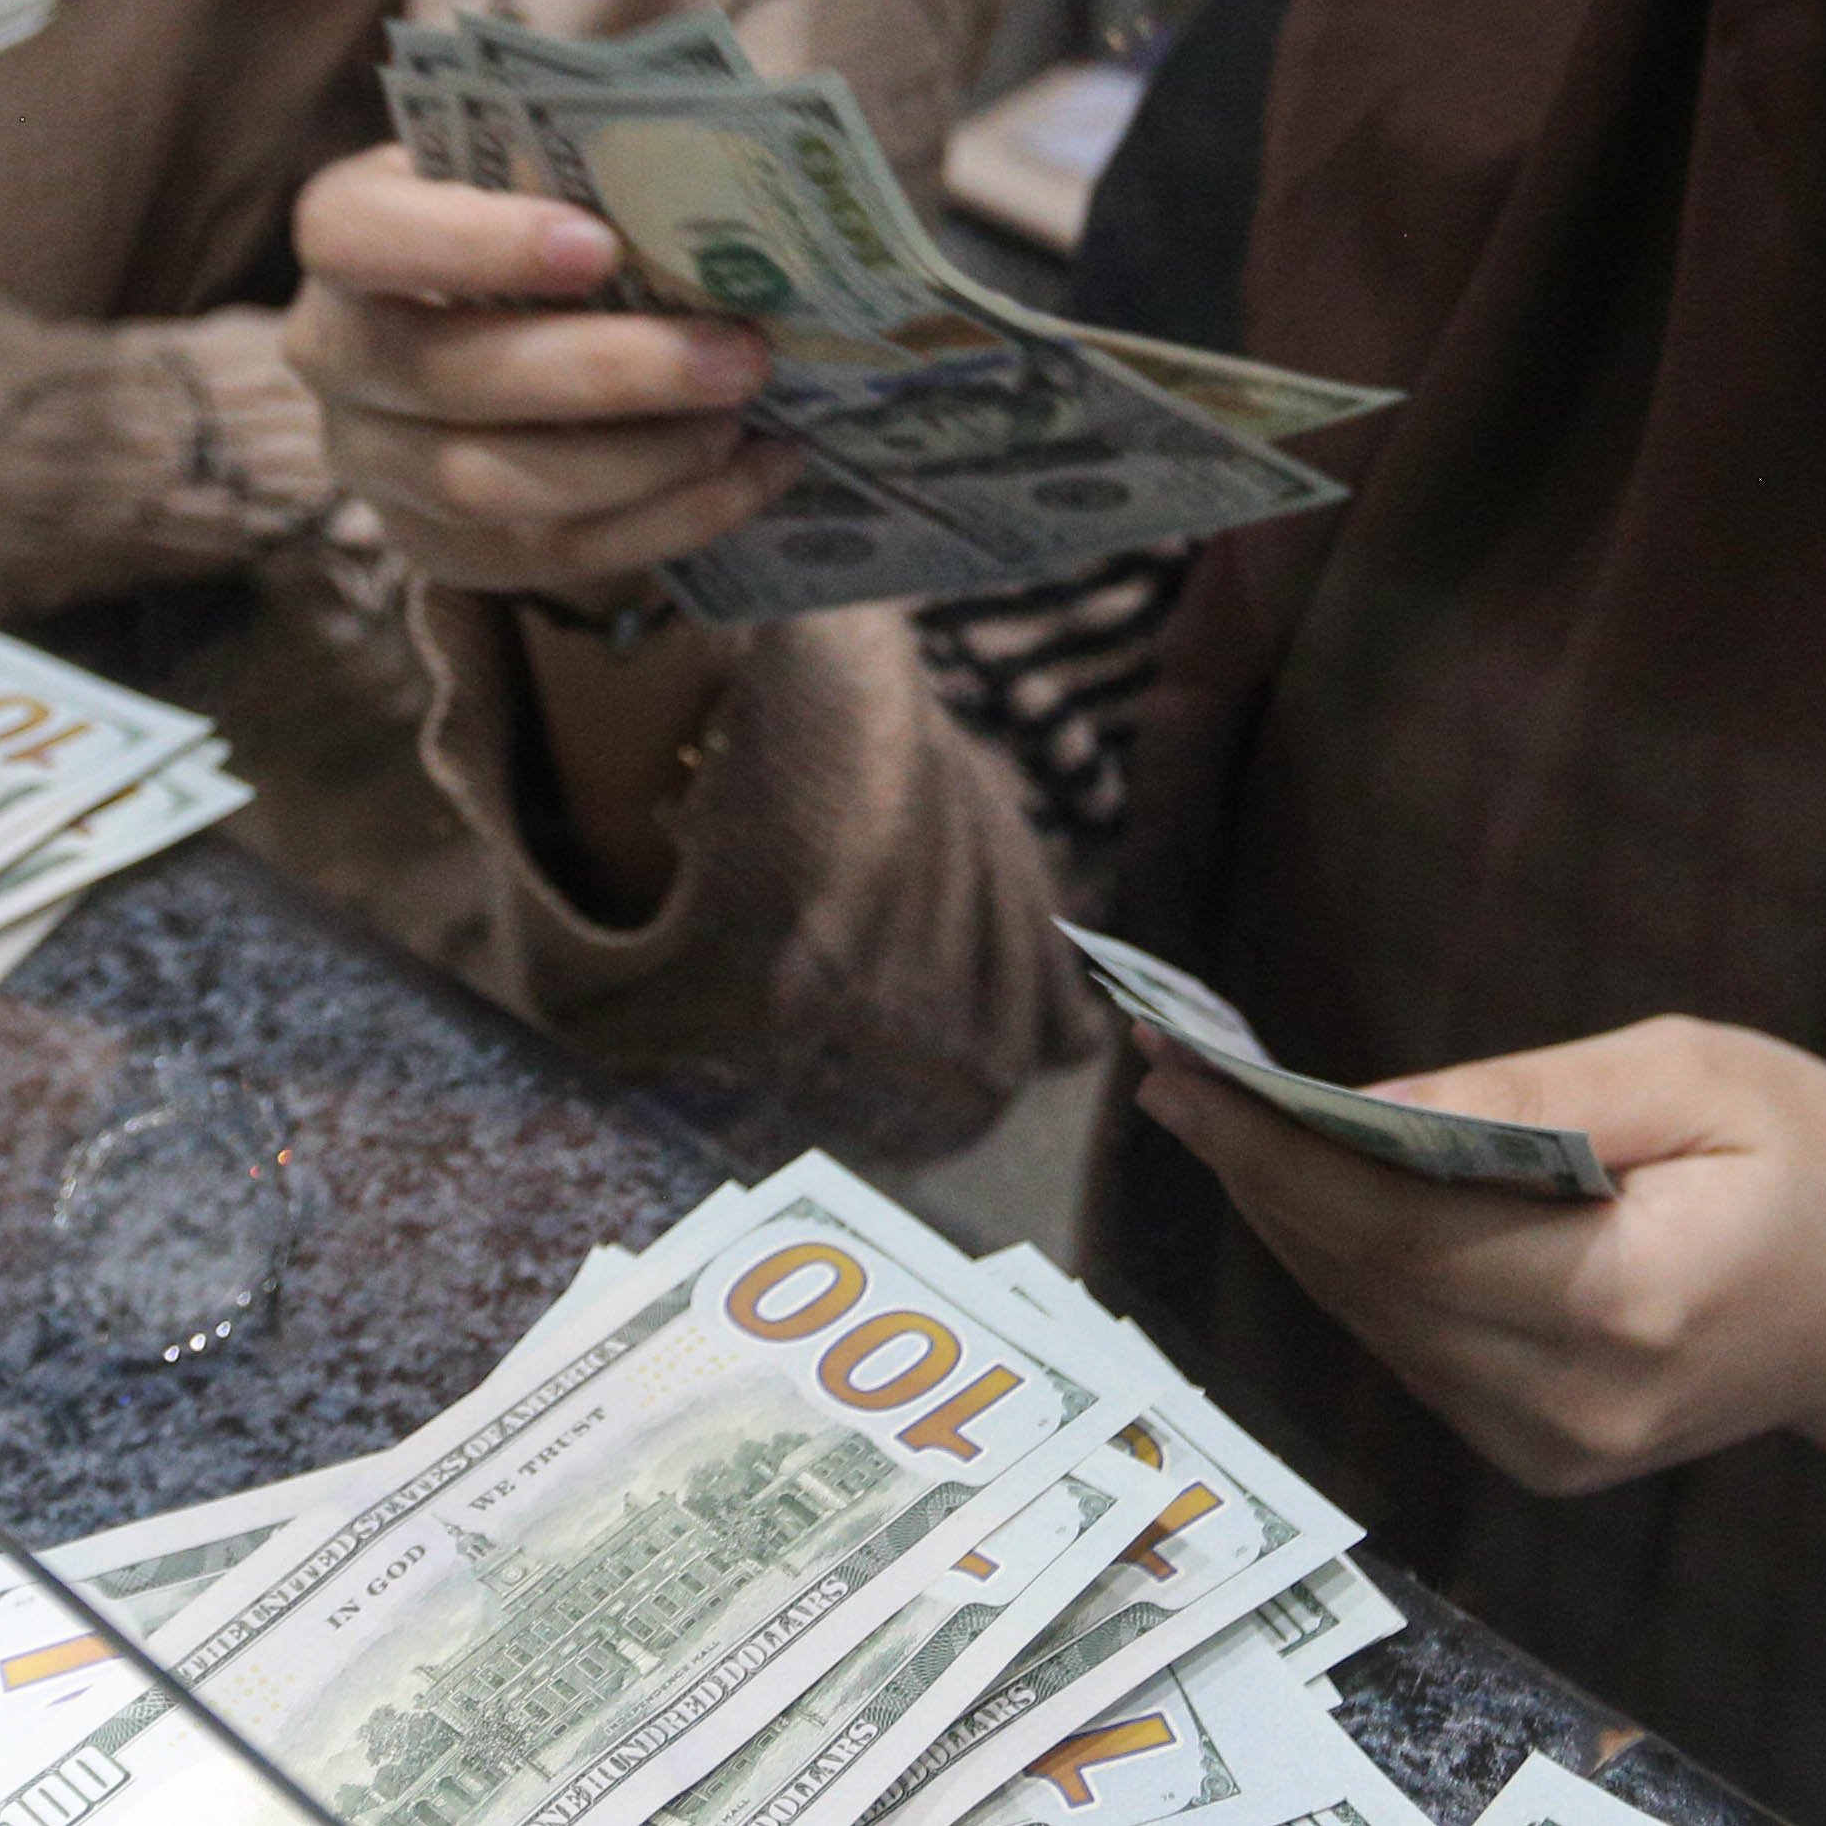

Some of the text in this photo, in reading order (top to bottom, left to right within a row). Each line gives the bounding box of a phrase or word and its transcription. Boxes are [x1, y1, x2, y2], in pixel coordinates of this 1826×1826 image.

[352, 1457, 468, 1539] STATES
[499, 1338, 626, 1433] AMERICA
[724, 1241, 1025, 1463] 100
[326, 1406, 607, 1630] IN GOD WE TRUST
[584, 1680, 725, 1793] HUNDRED
[716, 1576, 849, 1685] DOLLARS
